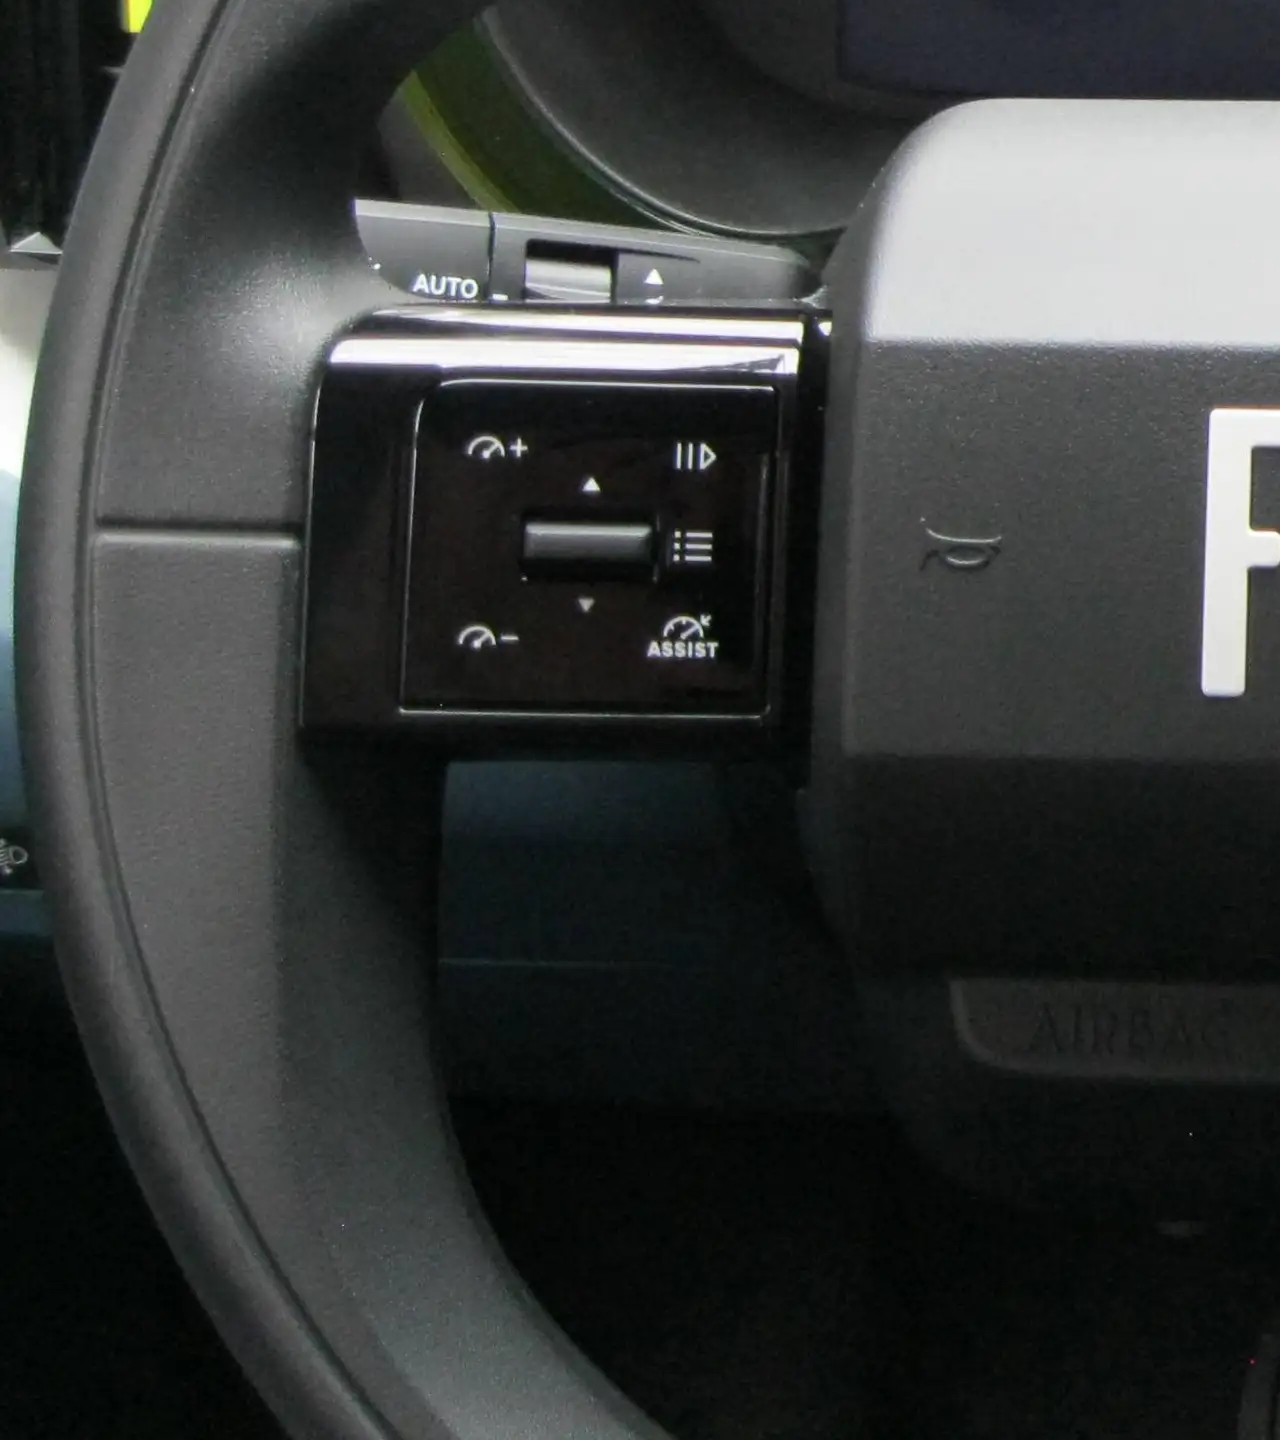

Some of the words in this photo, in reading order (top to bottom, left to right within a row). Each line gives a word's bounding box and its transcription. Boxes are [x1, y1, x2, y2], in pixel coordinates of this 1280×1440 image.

[412, 273, 479, 299] AUTO
[647, 640, 720, 659] ASSIST
[1028, 1001, 1229, 1058] AIRBAG
